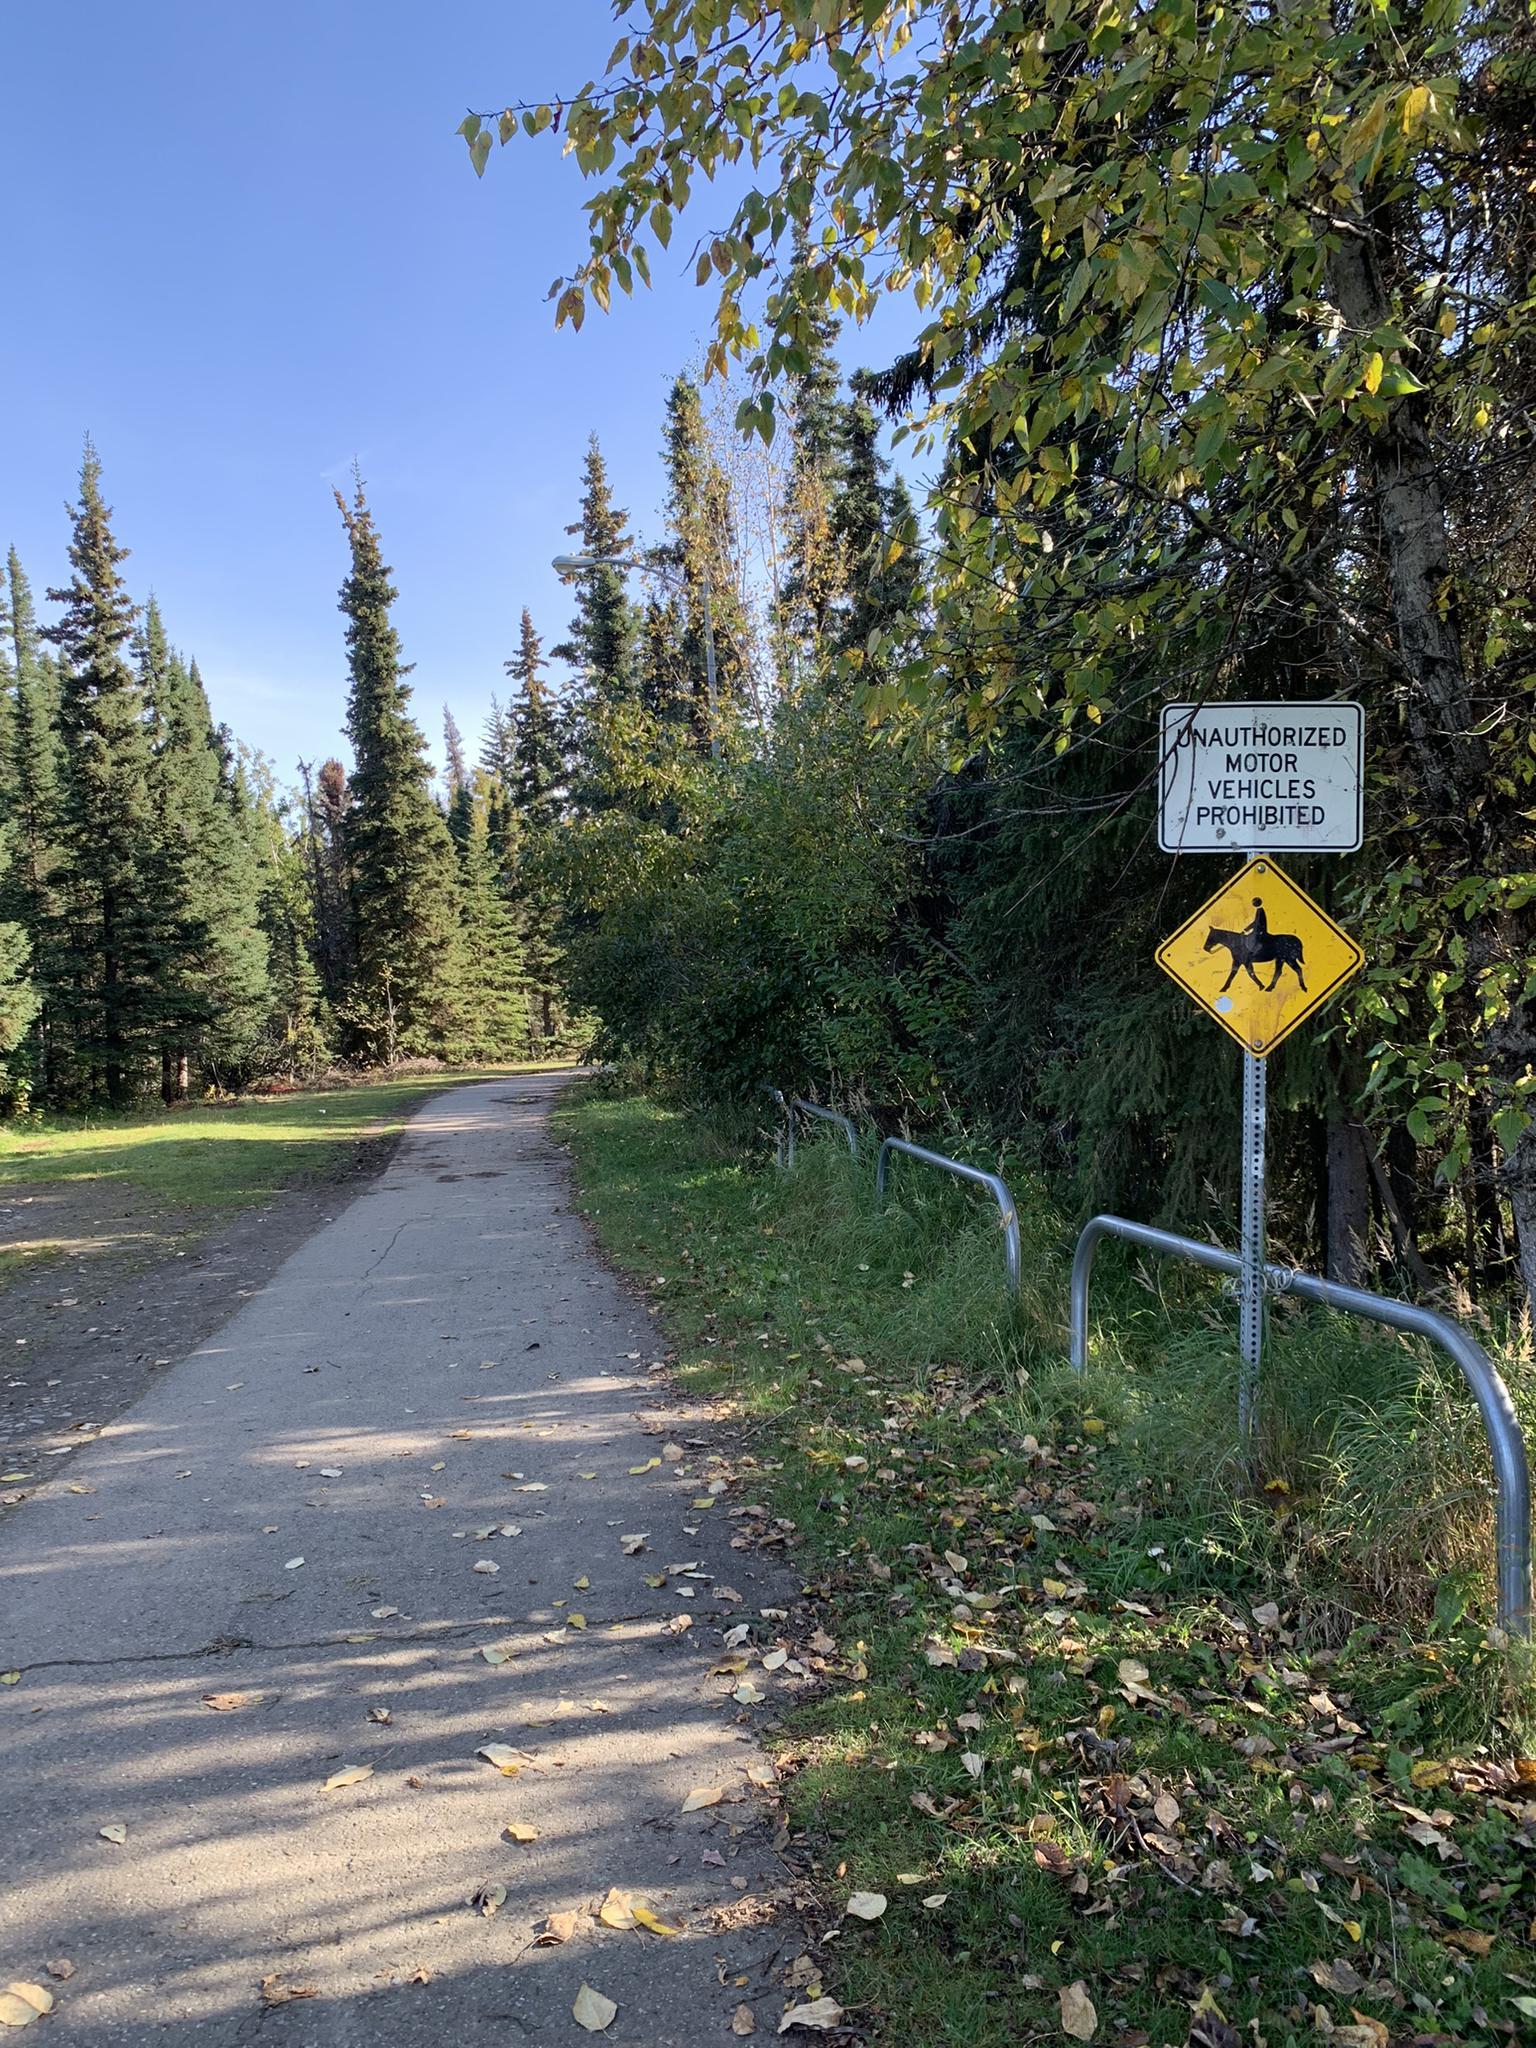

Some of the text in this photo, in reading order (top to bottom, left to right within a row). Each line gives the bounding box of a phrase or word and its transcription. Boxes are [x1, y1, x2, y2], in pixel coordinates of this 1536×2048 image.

[1177, 727, 1347, 748] UNAUTHORIZED
[1225, 753, 1298, 773] MOTOR
[1208, 779, 1316, 800] VEHICLES
[1196, 805, 1326, 826] PROHIBITED
